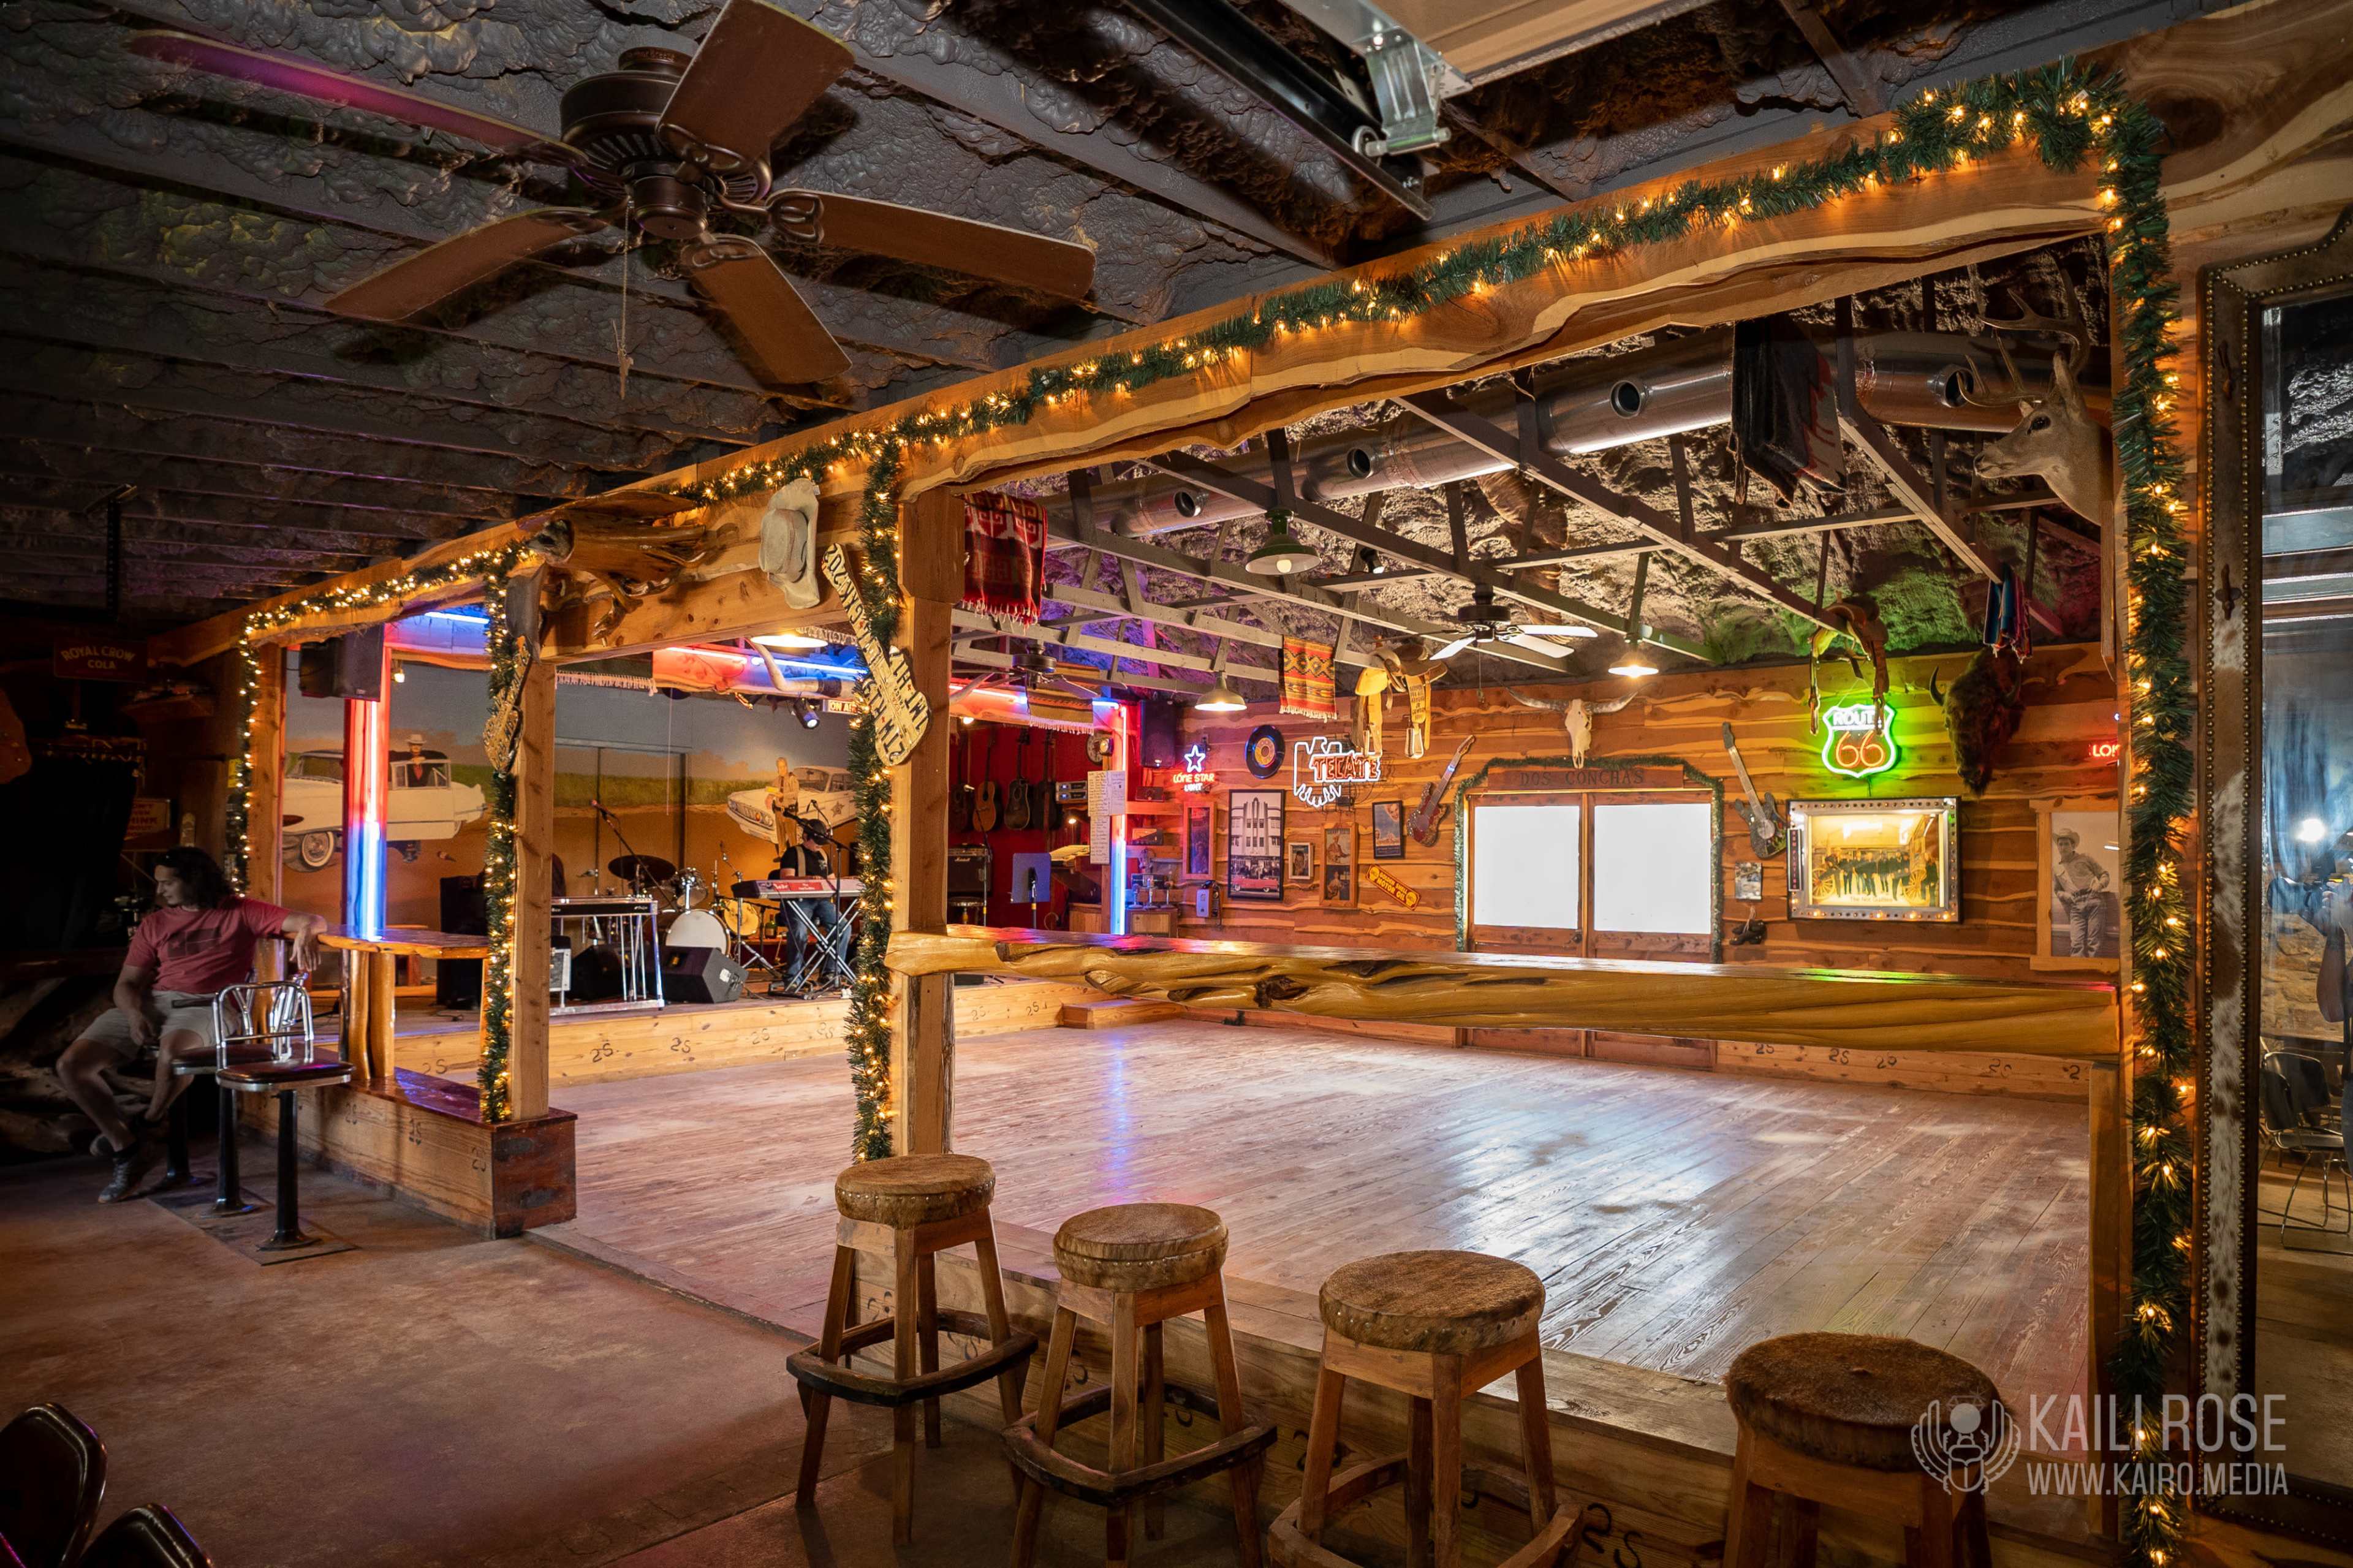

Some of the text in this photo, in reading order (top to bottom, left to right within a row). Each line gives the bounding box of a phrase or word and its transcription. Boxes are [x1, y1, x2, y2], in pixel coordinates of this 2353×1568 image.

[61, 645, 100, 662] ROYAL
[87, 659, 117, 669] COLA
[830, 701, 857, 713] ON AIR
[1836, 730, 1885, 768] 66
[1312, 754, 1379, 780] TECATE
[1173, 773, 1215, 783] LONE STAR
[1520, 768, 1645, 786] DOS CONCHAS
[1376, 877, 1396, 894] MOTOR
[1396, 891, 1406, 901] OIL
[1379, 872, 1408, 895] GOLDEN SHELL
